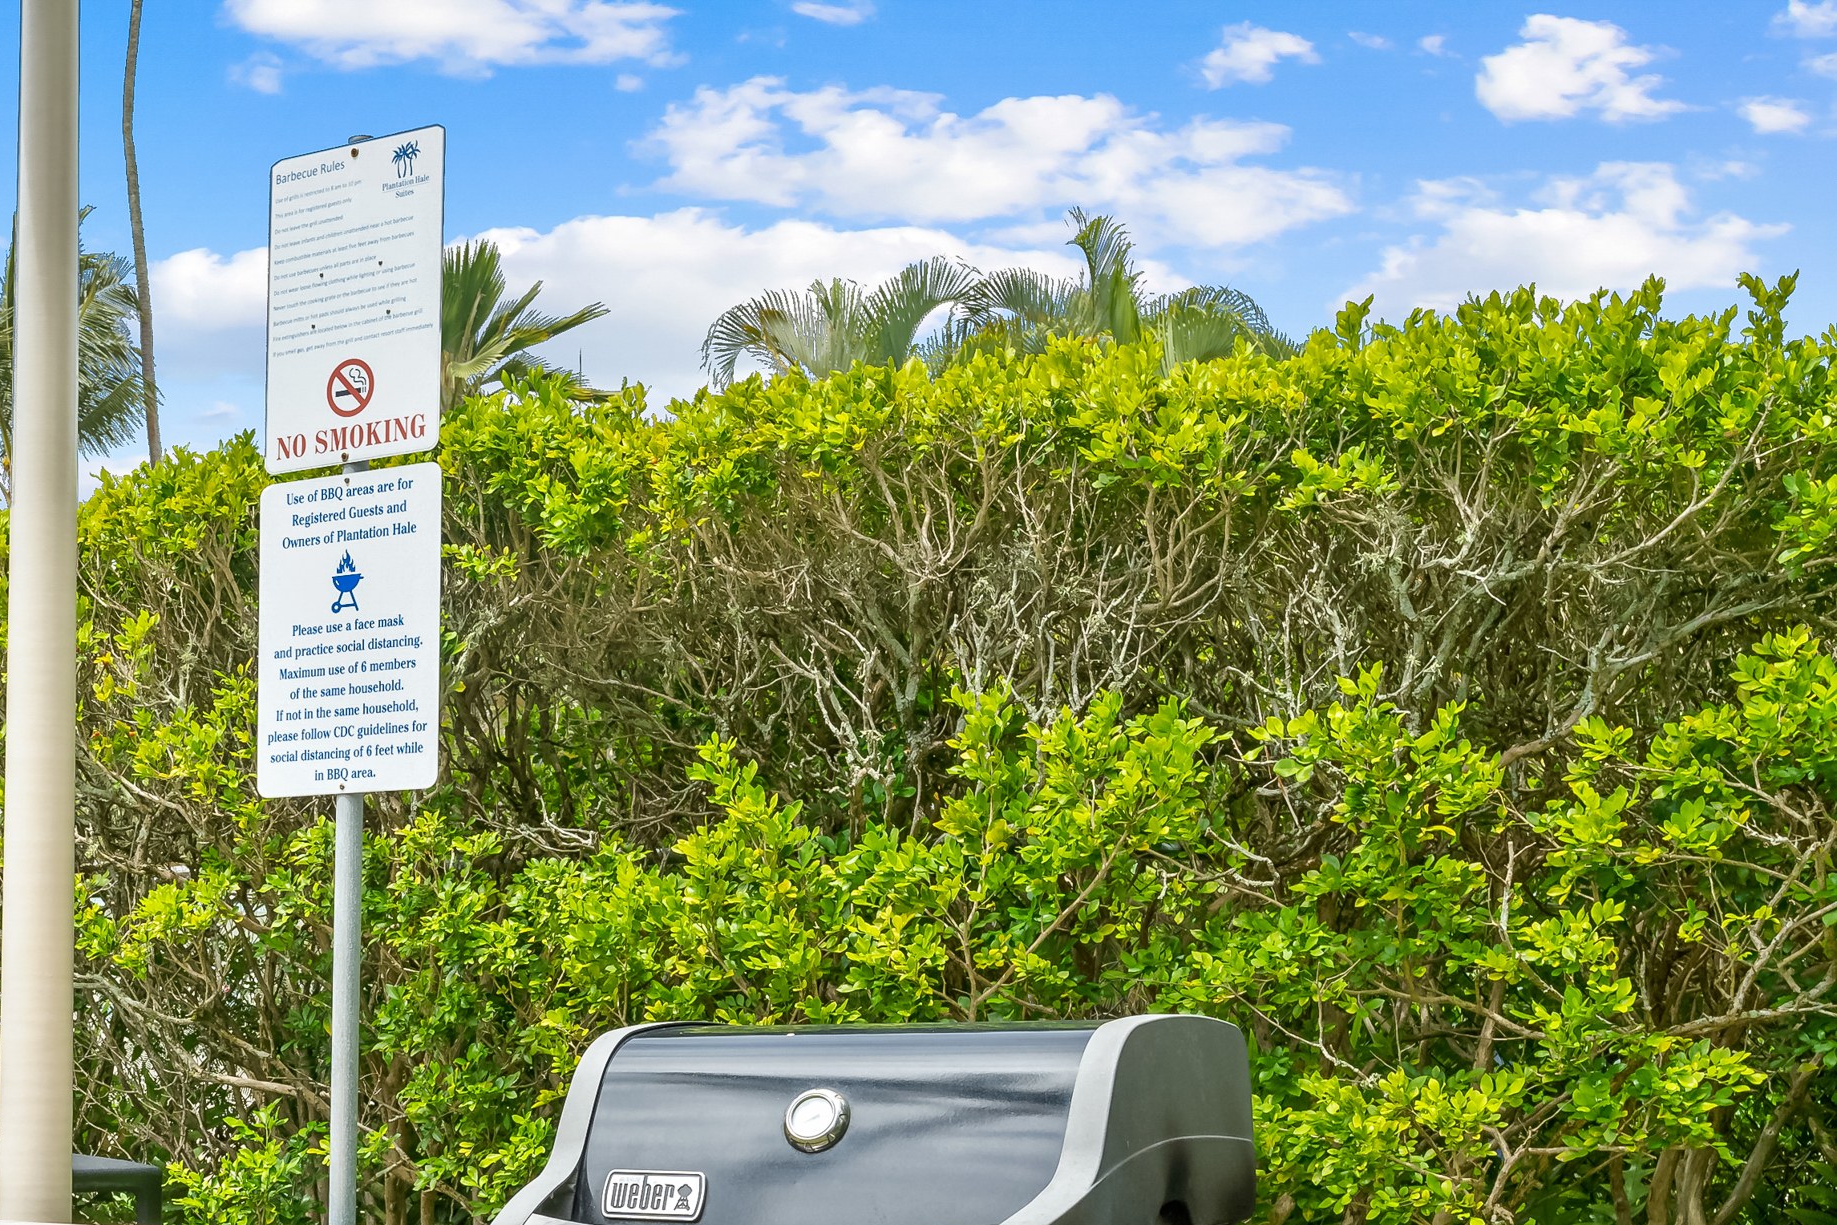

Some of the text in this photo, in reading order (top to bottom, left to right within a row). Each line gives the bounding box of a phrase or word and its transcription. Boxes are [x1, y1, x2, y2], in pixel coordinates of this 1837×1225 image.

[276, 161, 345, 185] Barbecue Rules
[382, 174, 429, 191] Plantation Hale
[395, 189, 414, 198] Suites
[277, 414, 425, 461] NO SMOKING
[286, 478, 413, 505] Use of BBQ areas are for
[292, 500, 407, 527] Registered Guests and
[282, 522, 417, 549] Owners of Plantation Hale
[292, 614, 404, 636] Please use a face mask
[274, 635, 423, 660] and practice social distancing.
[279, 658, 416, 679] Maximum use of 6 members
[290, 679, 404, 700] of the same household.
[276, 699, 418, 721] If not in the same household,
[268, 720, 427, 745] please follow CDC guidelines for
[270, 742, 423, 763] social distancing of 6 feet while
[314, 768, 376, 781] in BBQ area.
[611, 1175, 675, 1210] weber
